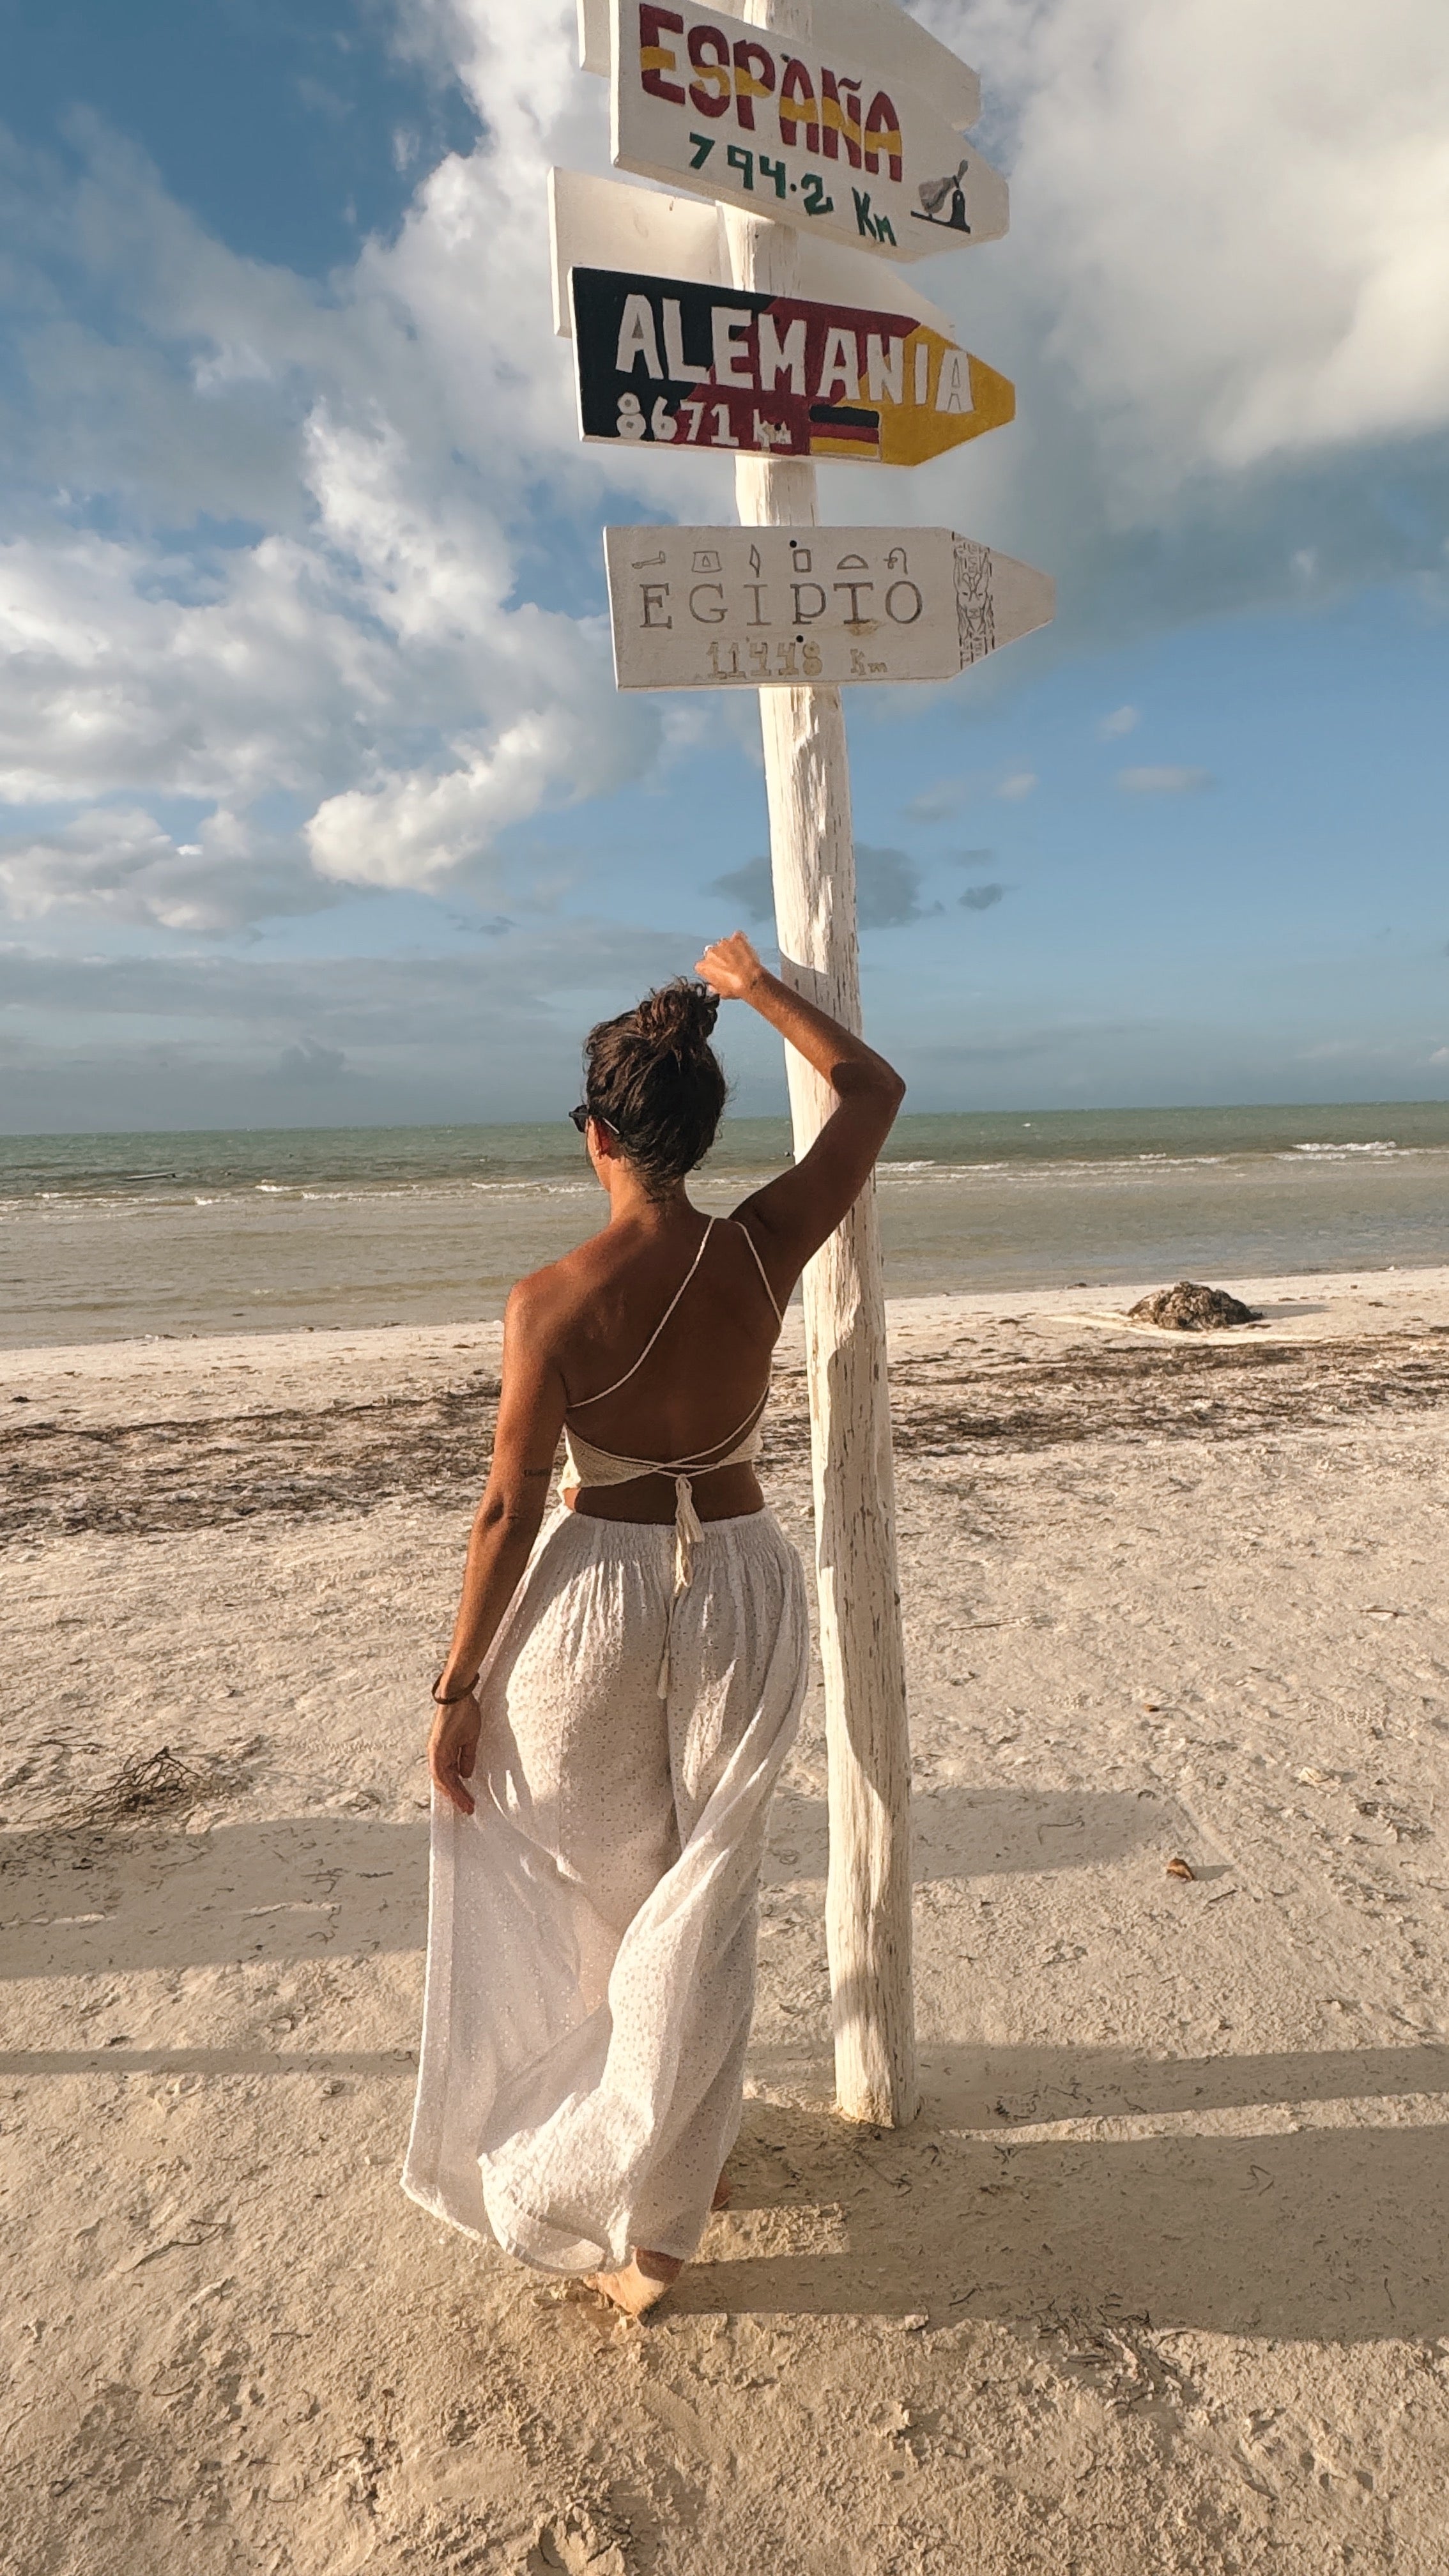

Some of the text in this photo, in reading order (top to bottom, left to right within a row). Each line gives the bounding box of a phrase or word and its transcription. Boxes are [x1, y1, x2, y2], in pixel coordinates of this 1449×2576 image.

[640, 3, 903, 183] ESPAÑA
[615, 293, 974, 414] ALEMANIA
[617, 392, 739, 447] 8671
[640, 580, 923, 629] EGIPTO
